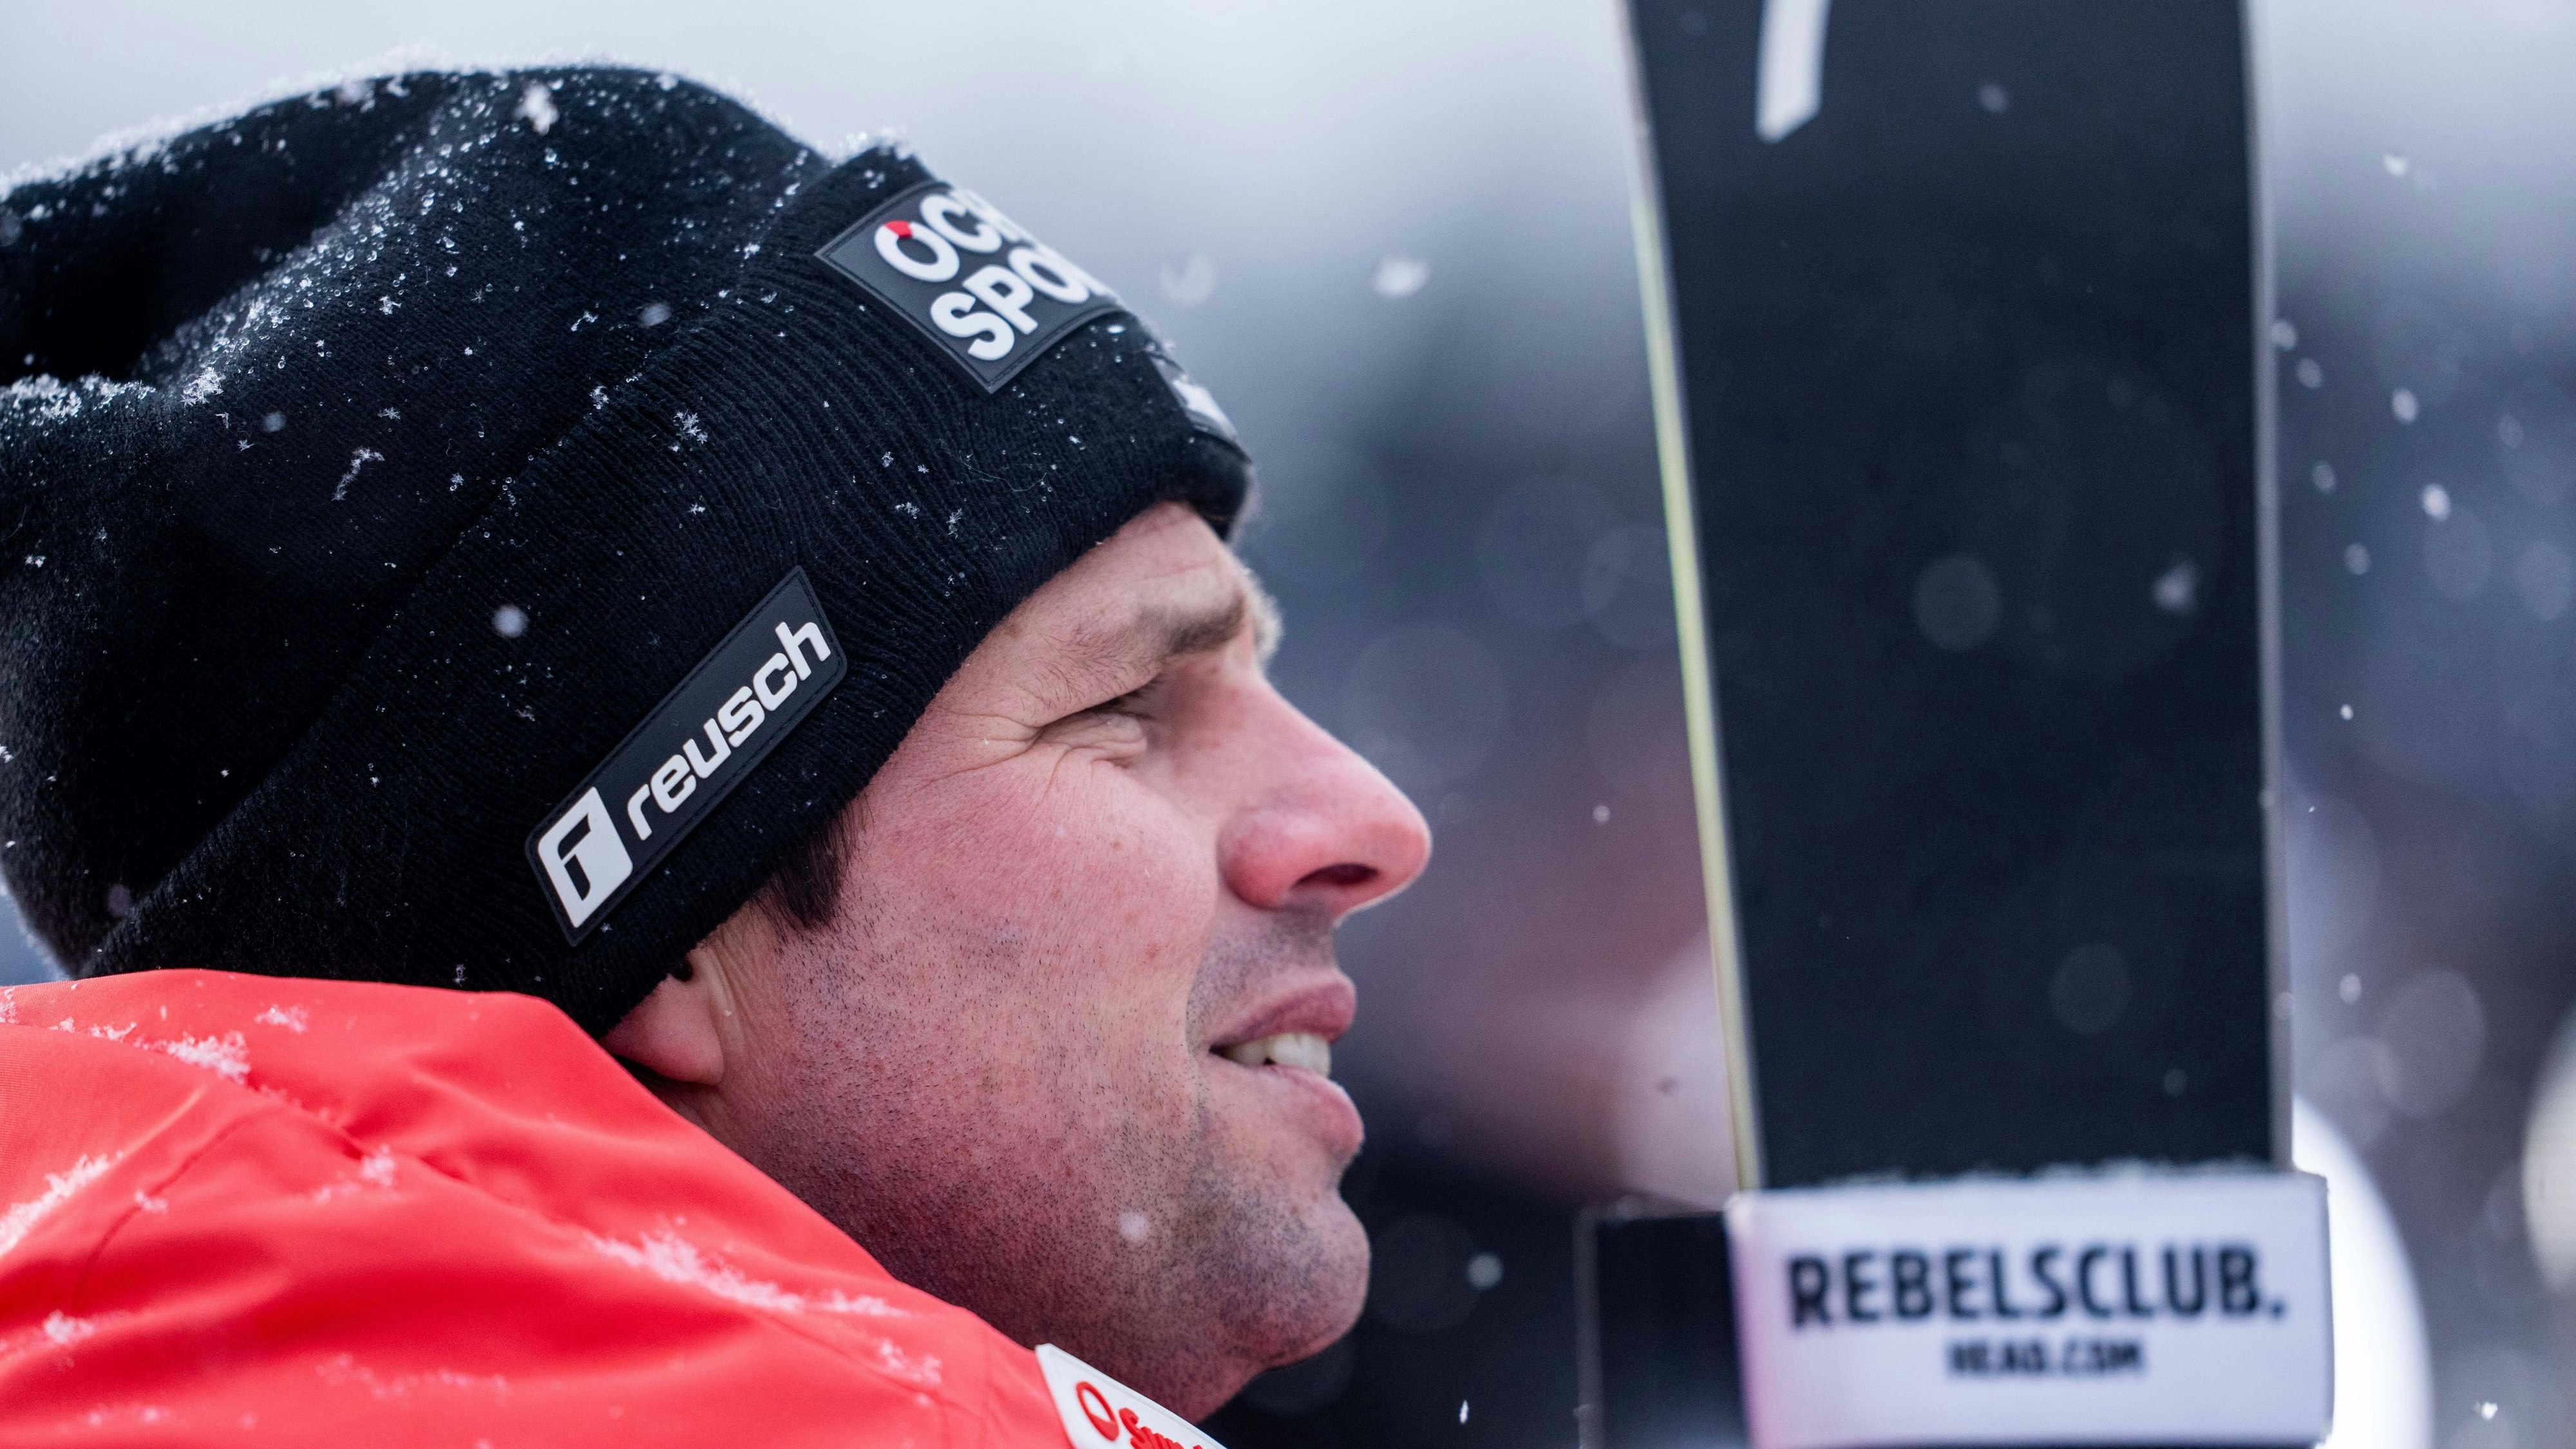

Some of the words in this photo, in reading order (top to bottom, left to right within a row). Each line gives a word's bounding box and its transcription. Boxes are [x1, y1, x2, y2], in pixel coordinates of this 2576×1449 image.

[931, 246, 1109, 361] SPO
[627, 621, 831, 840] reusch
[1786, 1243, 2286, 1327] REBELSCLUB.
